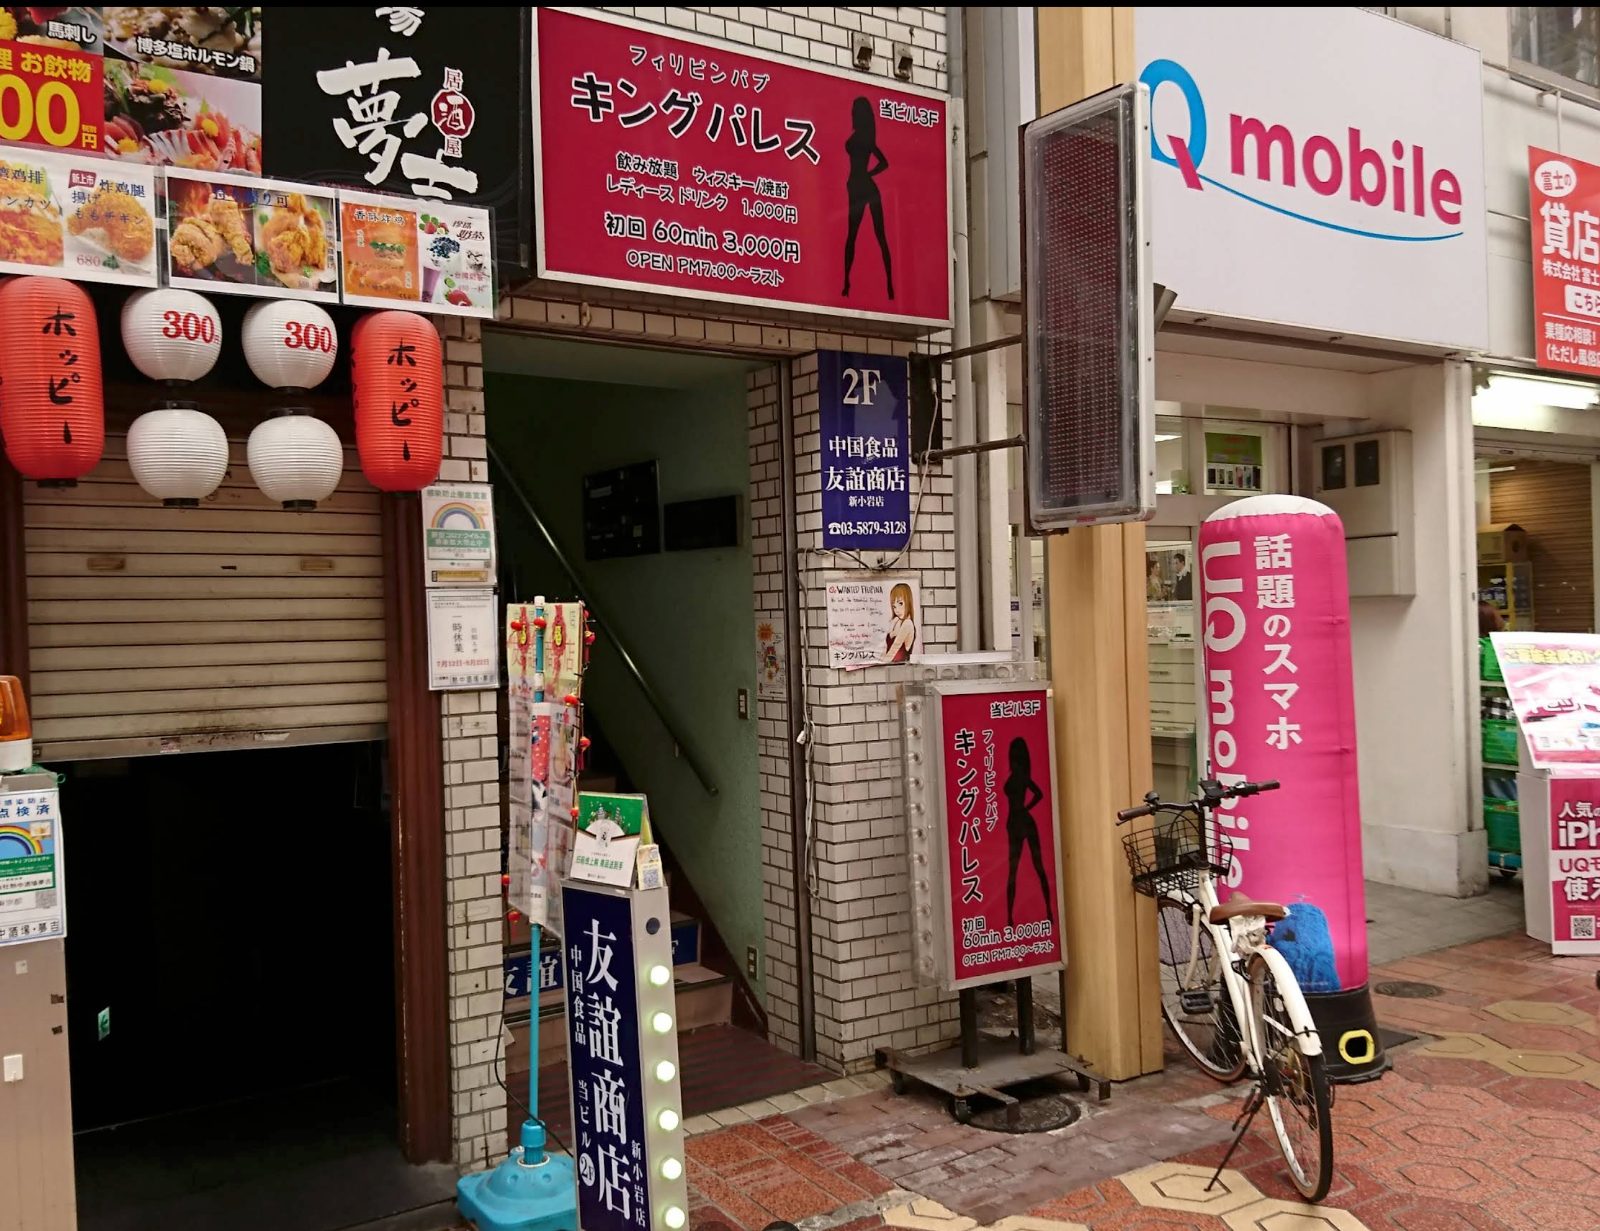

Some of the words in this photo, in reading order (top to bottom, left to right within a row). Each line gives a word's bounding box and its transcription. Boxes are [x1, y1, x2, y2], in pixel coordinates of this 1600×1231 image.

[47, 20, 97, 43] 馬刺し
[21, 52, 92, 83] お飲物
[136, 37, 256, 74] 博多塩ホルモン鍋
[629, 45, 770, 93] フィリピンパブ
[431, 66, 475, 158] 居酒屋
[571, 72, 821, 165] キングパレス
[879, 99, 939, 127] 当ビル3F
[616, 151, 678, 179] 飲み放題
[692, 166, 789, 198] ウィスキー/焼酎
[1229, 113, 1462, 225] mobile
[1541, 170, 1572, 191] 富士の
[607, 174, 675, 203] レディース
[678, 187, 728, 210] ドリンク
[741, 199, 798, 223] 1,000円
[604, 212, 646, 239] 初回
[653, 220, 718, 250] 60min
[723, 231, 801, 263] 3,000円
[1540, 200, 1600, 265] 貸店
[626, 249, 674, 273] OPEN
[42, 304, 81, 444] ホッピー
[1546, 343, 1600, 368] (ただし風俗
[387, 338, 420, 461] ホッピー
[842, 368, 881, 406] 2F
[829, 436, 898, 459] 中国食品
[824, 466, 905, 492] 友誼商店
[848, 495, 884, 508] 新小岩店
[1202, 541, 1247, 653] UQ
[1253, 533, 1303, 750] 話題のスマホ
[990, 700, 1041, 719] 当ビル3F
[982, 729, 999, 832] フィリピンパブ
[954, 728, 984, 904] キングパレス
[962, 915, 986, 933] 初回
[963, 929, 1002, 949] 60min
[1004, 919, 1052, 942] 3,000円
[962, 950, 990, 967] OPEN
[583, 918, 631, 1220] 友誼商店
[631, 1140, 646, 1228] 新小岩店
